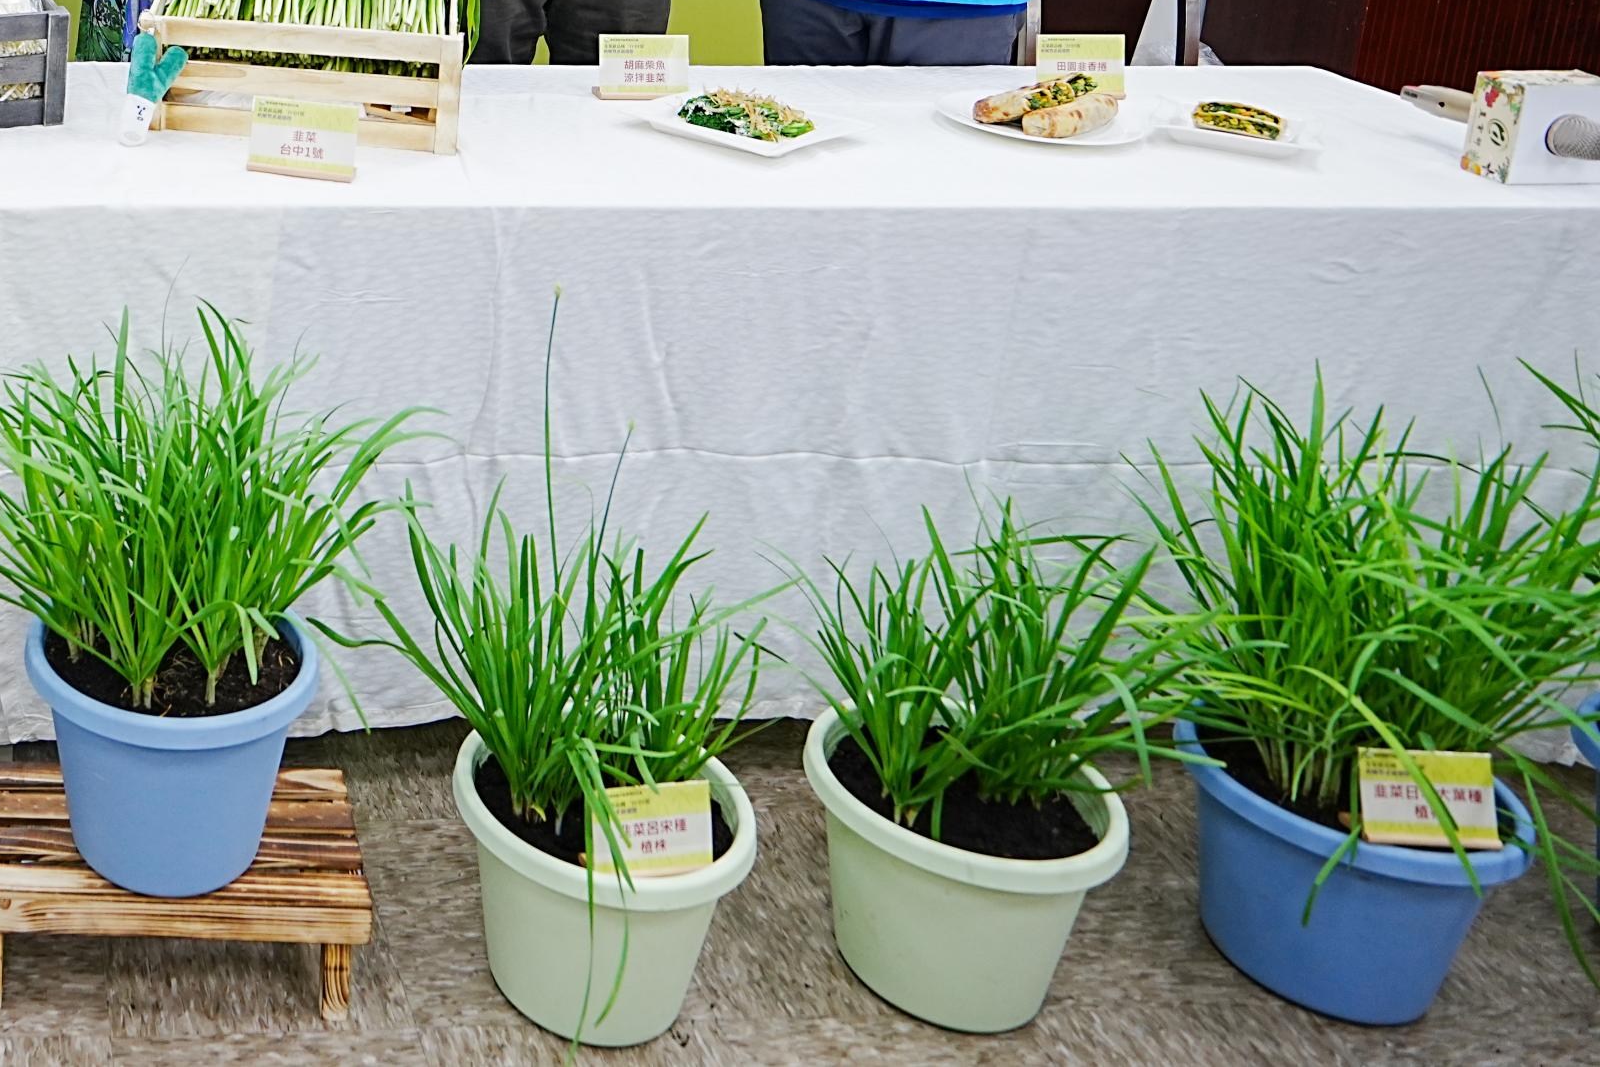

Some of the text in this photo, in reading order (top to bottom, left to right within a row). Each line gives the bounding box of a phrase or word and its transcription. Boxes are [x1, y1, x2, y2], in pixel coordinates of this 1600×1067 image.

[292, 129, 318, 143] 韭菜
[279, 143, 325, 160] 台中1號
[1374, 783, 1483, 804] 韭菜日大葉種
